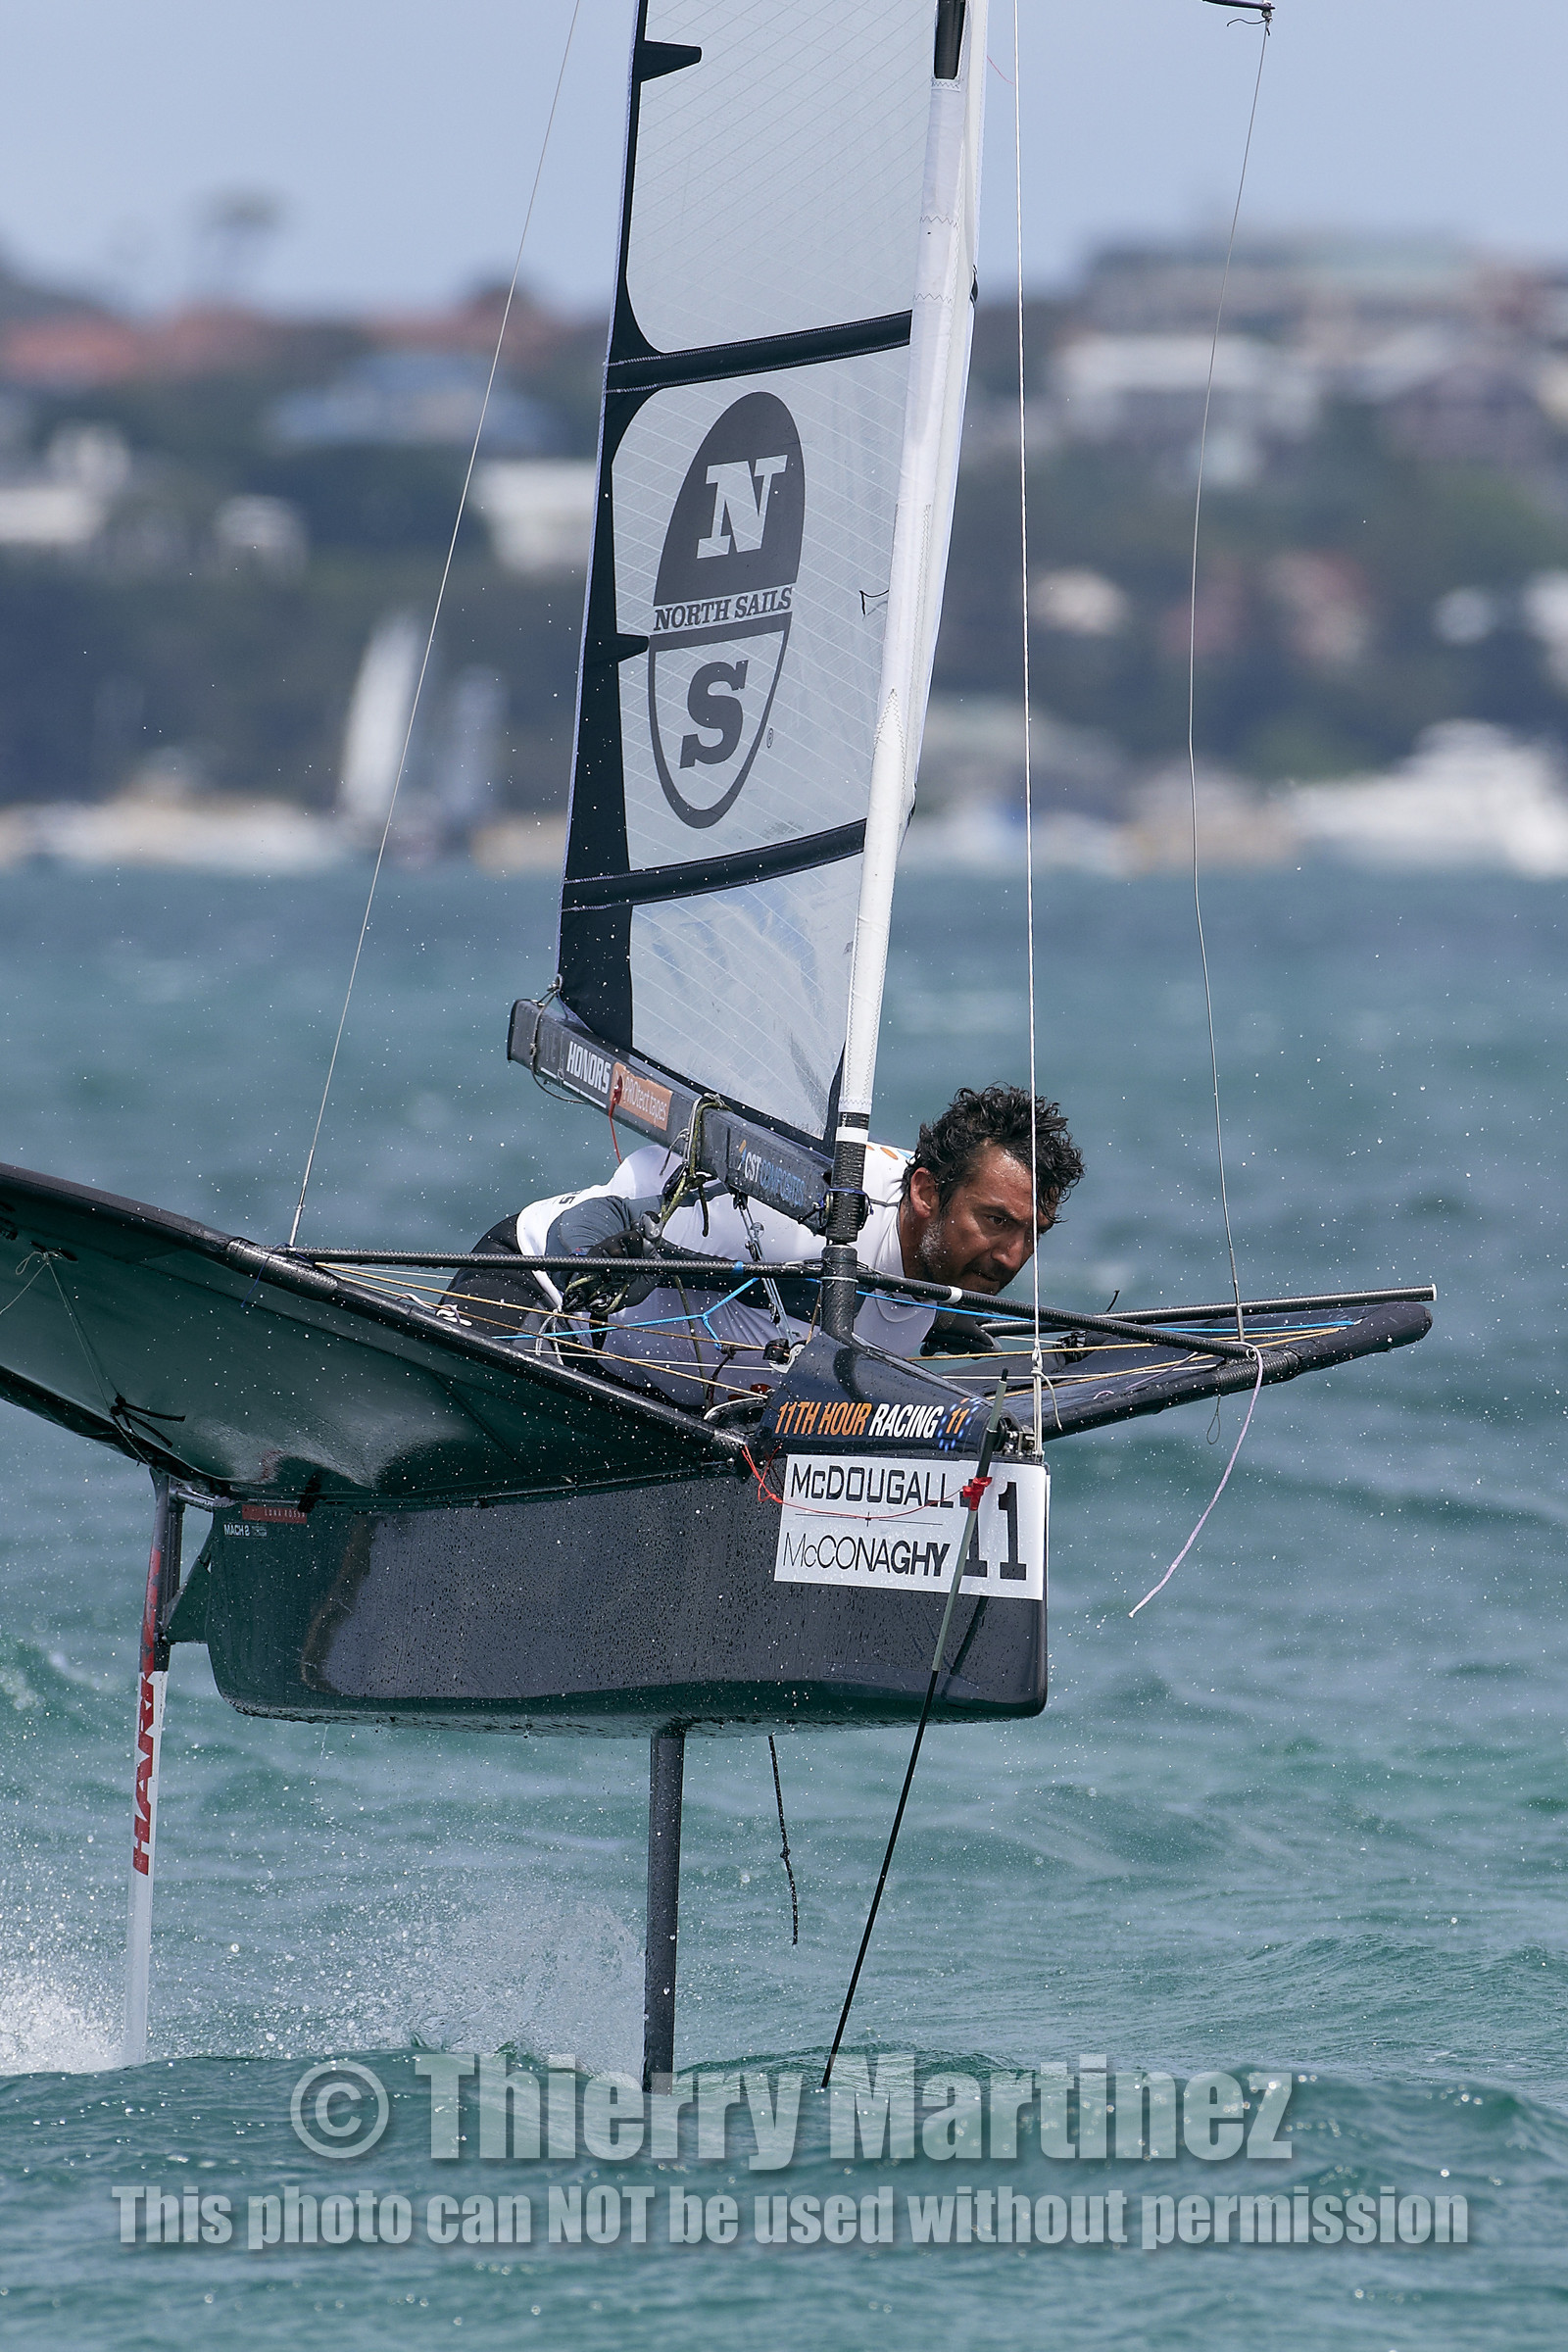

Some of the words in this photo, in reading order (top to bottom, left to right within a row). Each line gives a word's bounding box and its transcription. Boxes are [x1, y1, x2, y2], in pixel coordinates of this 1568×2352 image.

[697, 454, 788, 560] N
[654, 599, 731, 631] NORTH
[734, 586, 792, 618] SAILS
[679, 660, 749, 768] S
[566, 1041, 612, 1094] HONORS
[774, 1401, 822, 1436] 11TH
[816, 1401, 872, 1437] HOUR
[868, 1403, 945, 1439] RACING
[945, 1407, 970, 1435] 11
